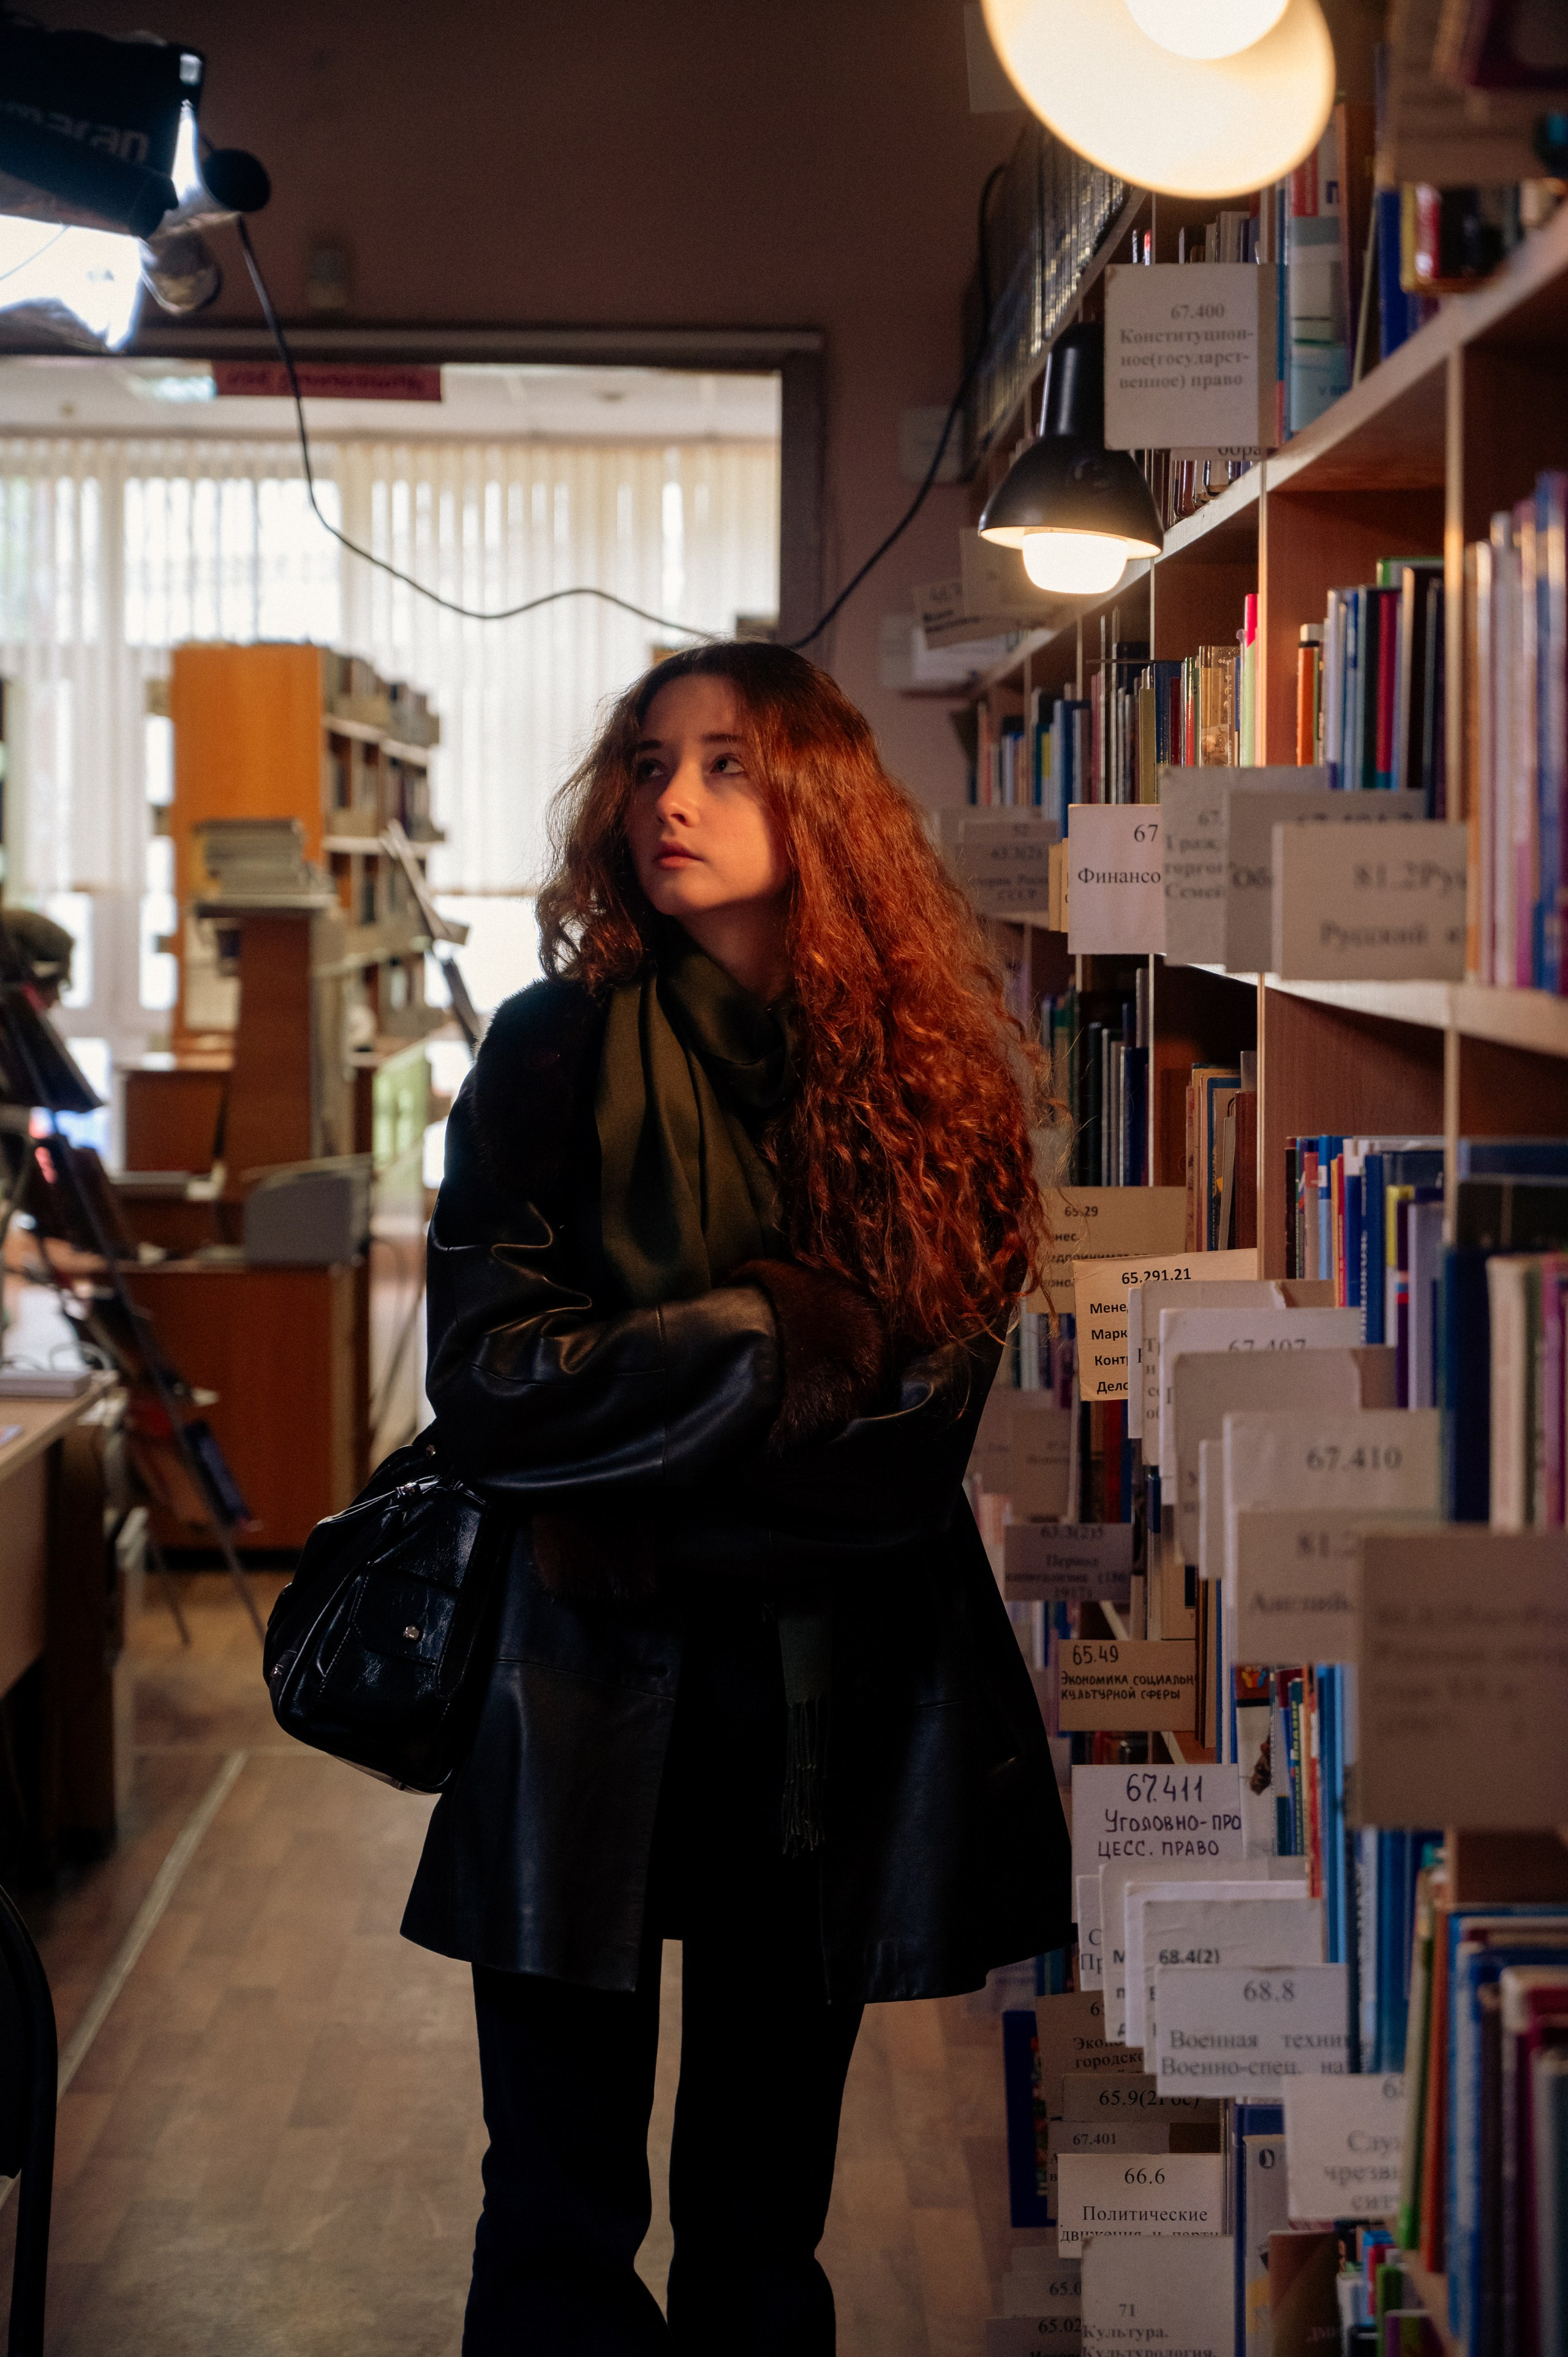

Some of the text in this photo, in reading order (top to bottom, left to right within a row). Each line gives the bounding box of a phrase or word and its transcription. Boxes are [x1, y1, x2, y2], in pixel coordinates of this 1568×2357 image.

[0, 101, 149, 162] maran
[1170, 303, 1225, 319] 67.400
[1120, 329, 1253, 344] Конституцион-
[1191, 374, 1243, 390] право
[1133, 823, 1159, 843] 67
[1077, 867, 1162, 884] Финансо
[1121, 1268, 1191, 1285] 65.291.21
[1090, 1303, 1128, 1314] Мене
[1095, 1355, 1128, 1367] Конт
[1305, 1444, 1404, 1471] 67.410
[1072, 1645, 1120, 1666] 65.49
[1126, 1773, 1204, 1803] 67.411
[1243, 1980, 1295, 2002] 68.8
[1170, 2029, 1258, 2049] Военная
[1072, 2132, 1117, 2145] 67.401
[1124, 2167, 1165, 2184] 66.6
[1082, 2206, 1208, 2222] Политические
[1118, 2302, 1136, 2318] 71
[1082, 2324, 1169, 2341] Культура.
